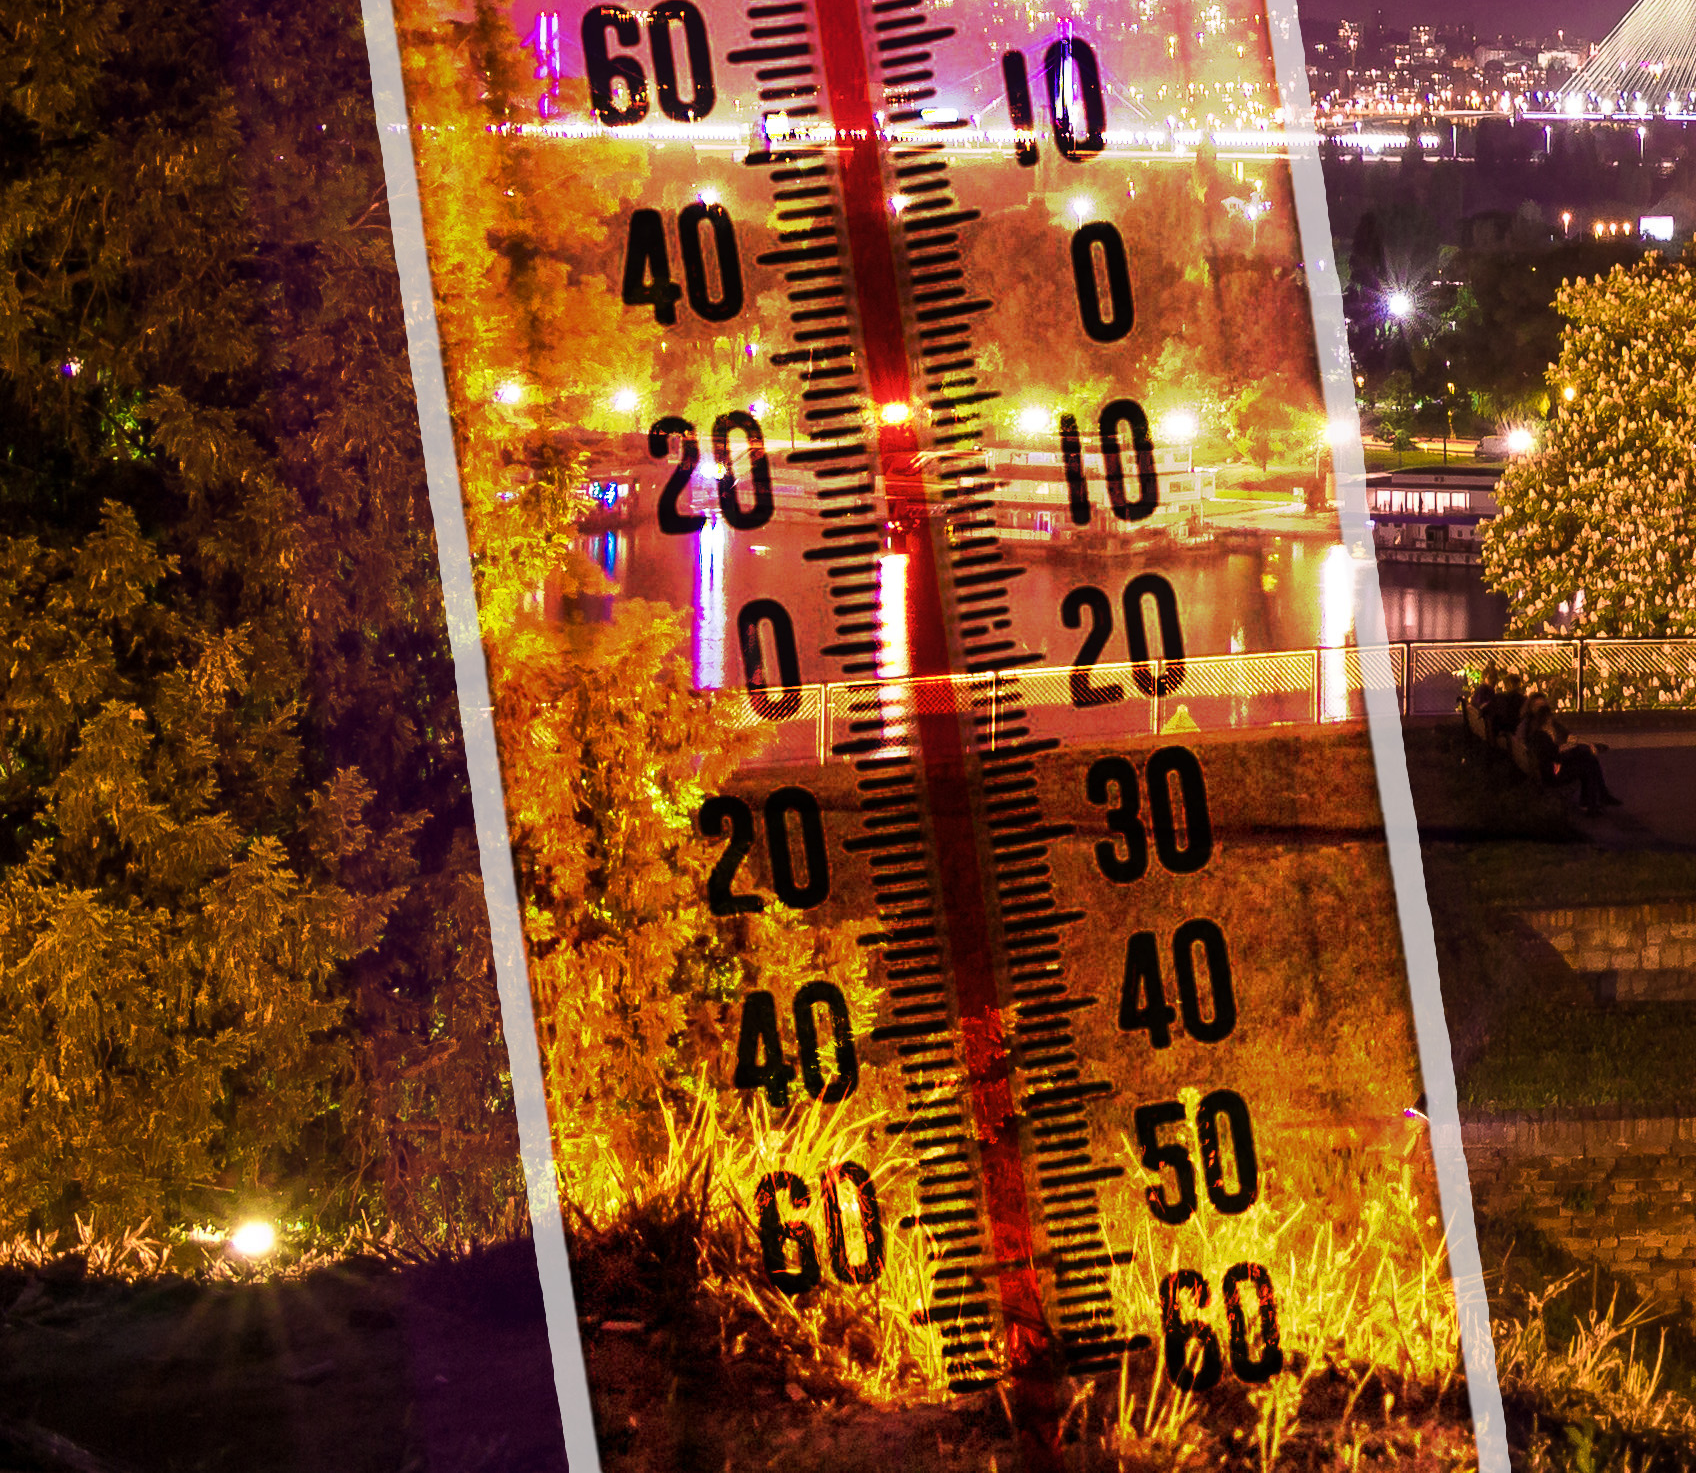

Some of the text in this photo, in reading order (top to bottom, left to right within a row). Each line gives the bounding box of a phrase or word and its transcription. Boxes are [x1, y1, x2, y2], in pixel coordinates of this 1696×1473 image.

[1001, 37, 1107, 167] 10
[621, 202, 745, 326] 40
[1071, 220, 1136, 343] 0
[649, 410, 773, 536] 20
[1058, 399, 1159, 526] 10
[737, 598, 802, 721] 0
[1061, 573, 1188, 709] 20
[700, 785, 832, 916] 20
[1086, 746, 1213, 884] 30
[734, 980, 858, 1107] 40
[1118, 918, 1236, 1049] 40
[1134, 1089, 1259, 1225] 50
[754, 1160, 884, 1294] 60
[1158, 1262, 1283, 1393] 60
